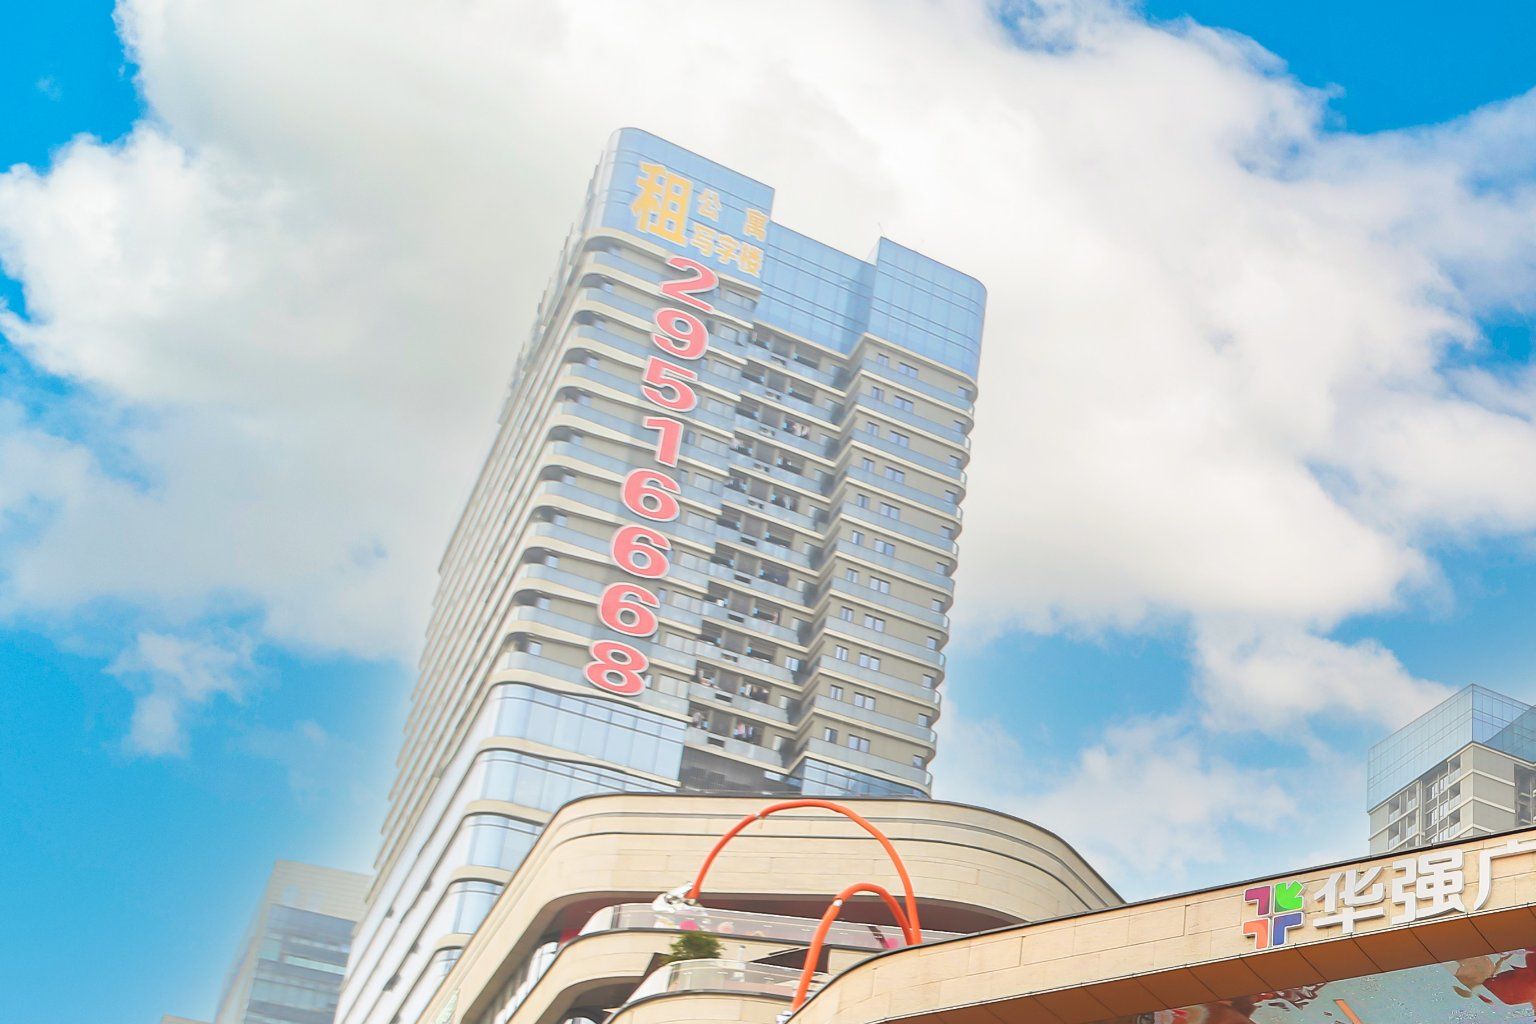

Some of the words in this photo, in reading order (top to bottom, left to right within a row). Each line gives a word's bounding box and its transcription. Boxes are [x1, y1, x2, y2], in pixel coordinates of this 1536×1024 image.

[630, 161, 692, 247] 租
[690, 223, 764, 278] 写字楼
[584, 256, 719, 696] 29516668
